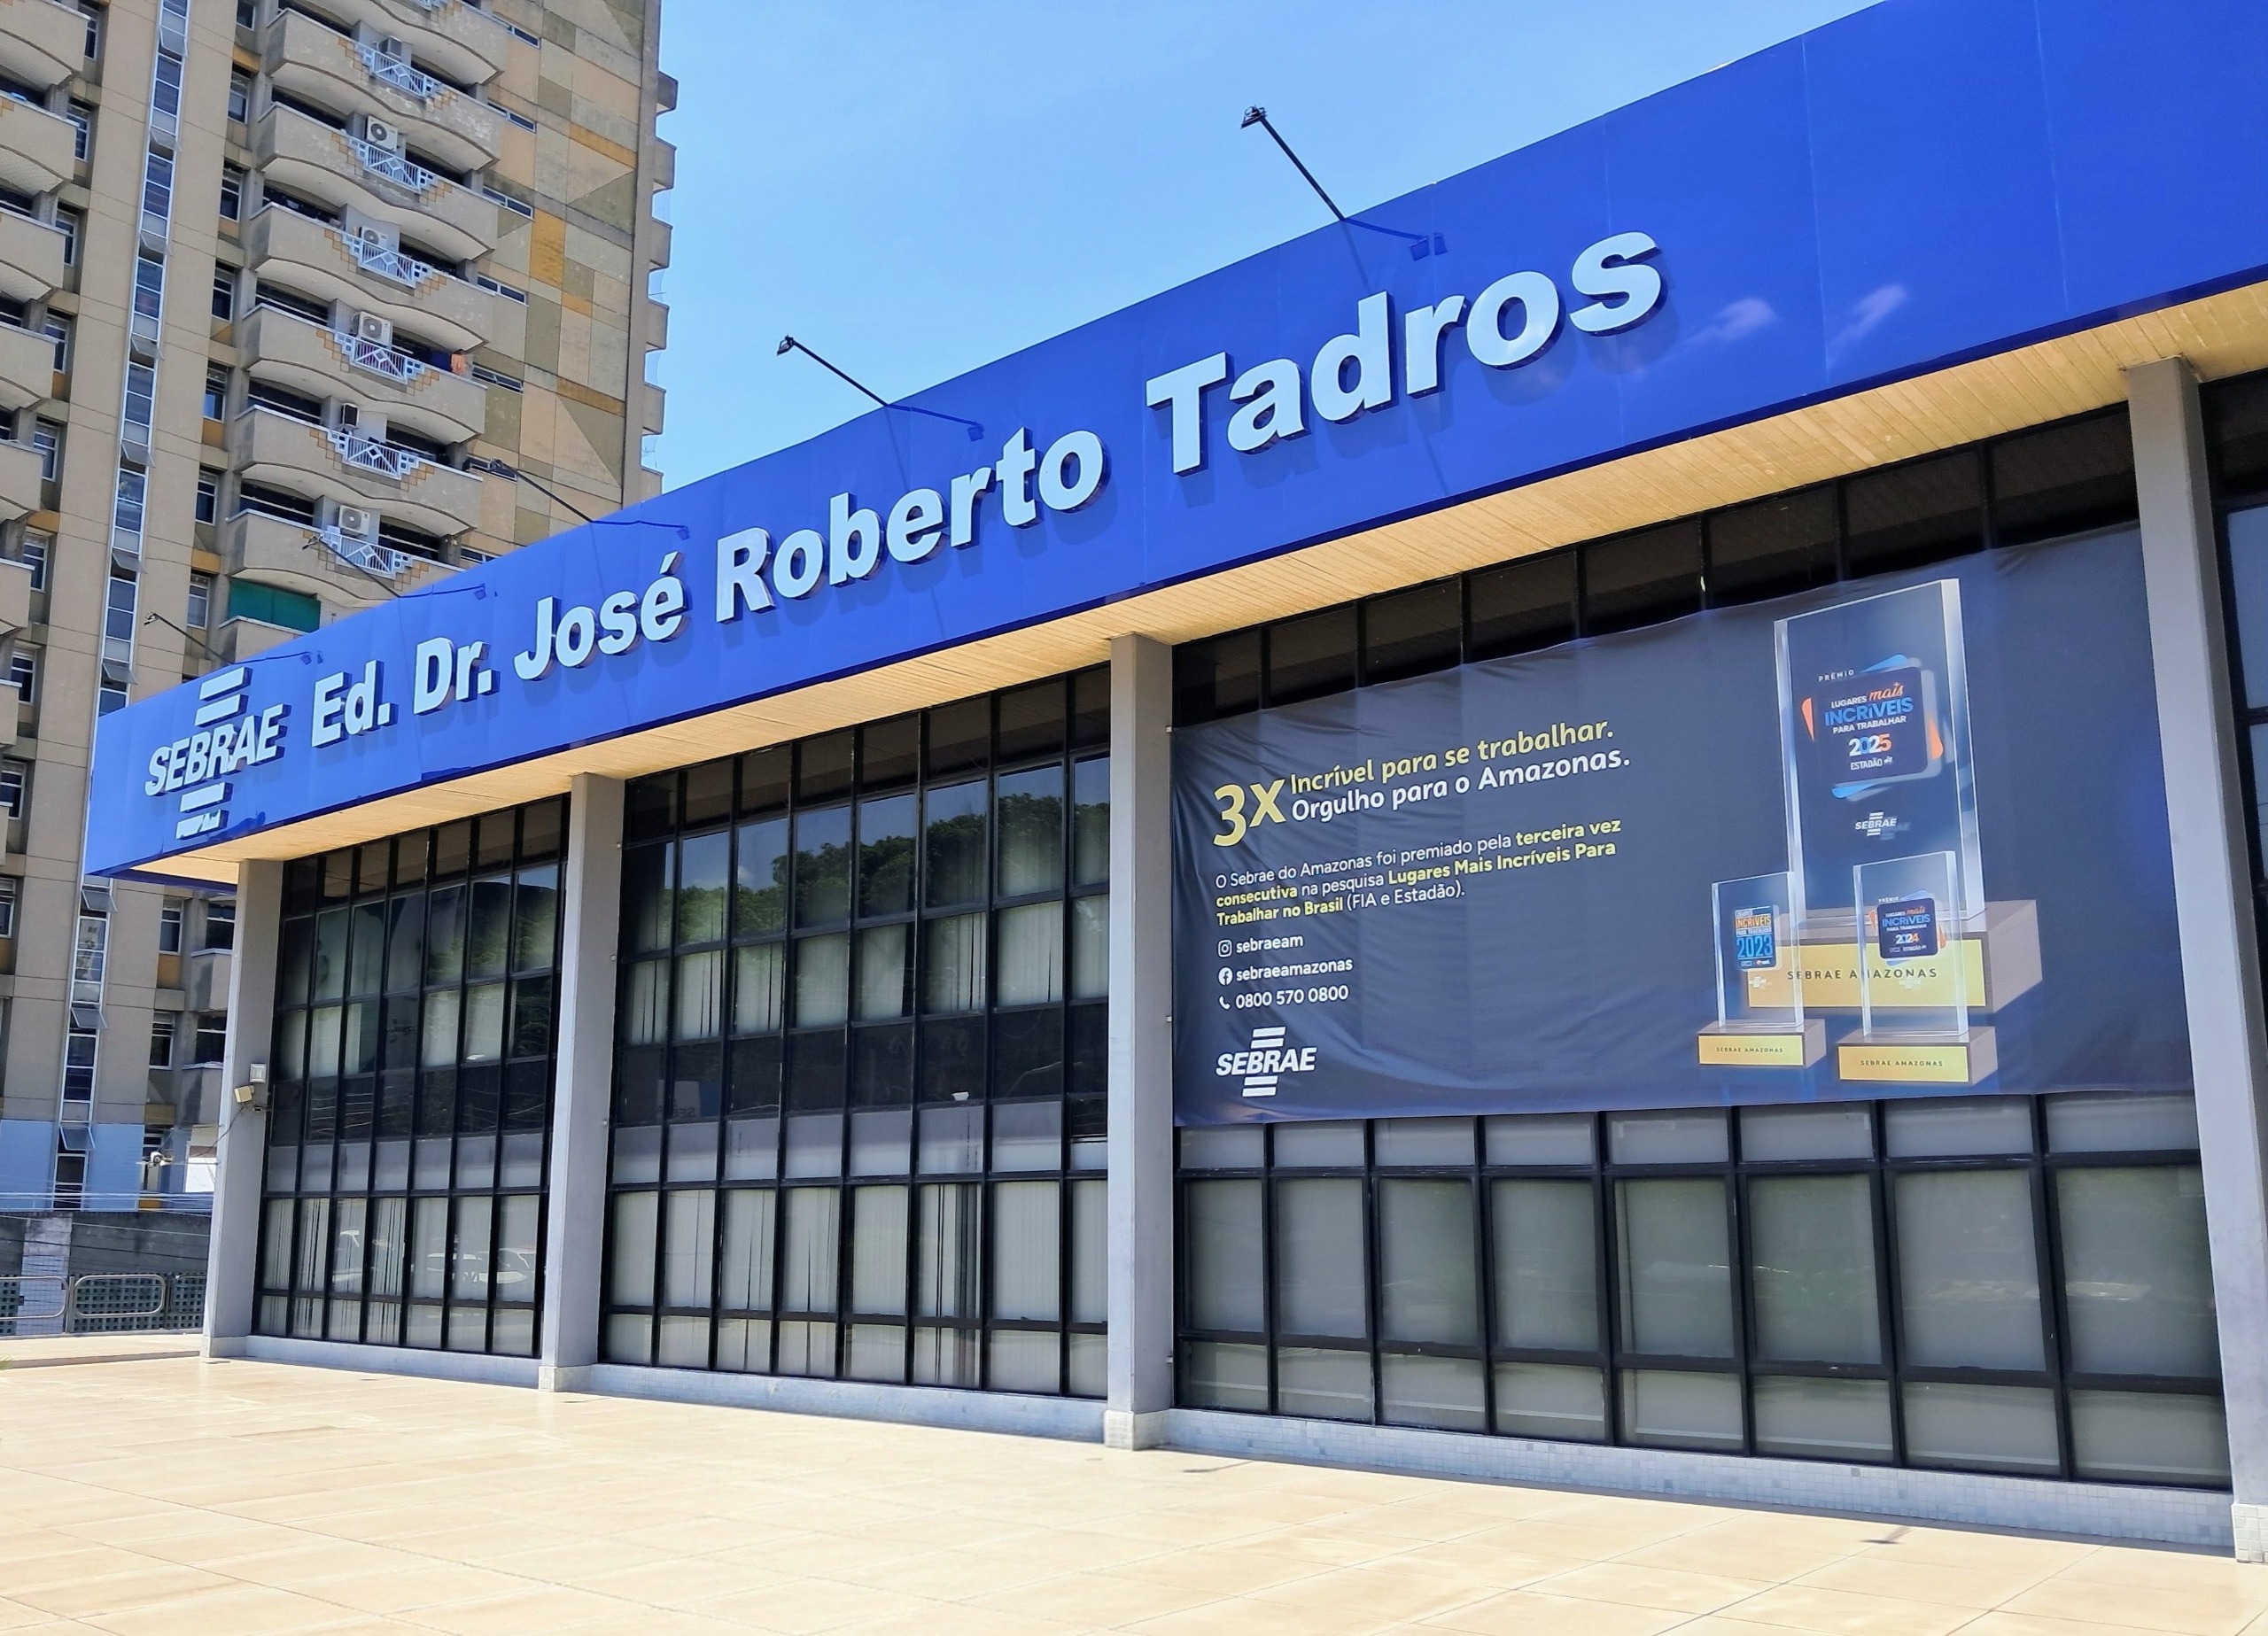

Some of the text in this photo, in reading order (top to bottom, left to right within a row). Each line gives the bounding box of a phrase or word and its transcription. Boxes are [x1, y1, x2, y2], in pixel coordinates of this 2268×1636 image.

[311, 231, 1666, 748] Ed. Dr. José Roberto Tadros
[1831, 681, 1904, 709] LUGARES mais
[1833, 716, 1907, 734] PARA TRABALHAR
[144, 703, 291, 797] SEBRAE
[1290, 720, 1614, 794] Incrível para se trabalhar.
[1849, 733, 1891, 756] 2025
[1851, 757, 1883, 770] ESTADÃO
[1292, 749, 1631, 823] Orgulho para o Amazonas.
[1854, 818, 1898, 830] SEBRAE
[1216, 819, 1622, 889] O Sebrae do Amazonas foi premiado pela terceira vez
[1216, 841, 1616, 907] consecutiva na pesquisa Lugares Mais Incríveis Para
[1216, 880, 1466, 927] Trabalhar no Brasil (FIA e Estadão).
[1236, 935, 1304, 954] sebraeam
[1736, 934, 1773, 958] 2023
[1895, 933, 1920, 944] 2024
[1236, 958, 1354, 981] sebraeamazonas
[1787, 970, 1841, 980] SEBRAE
[1236, 984, 1349, 1009] 0800 570 0800
[1216, 1046, 1317, 1076] SEBRAE
